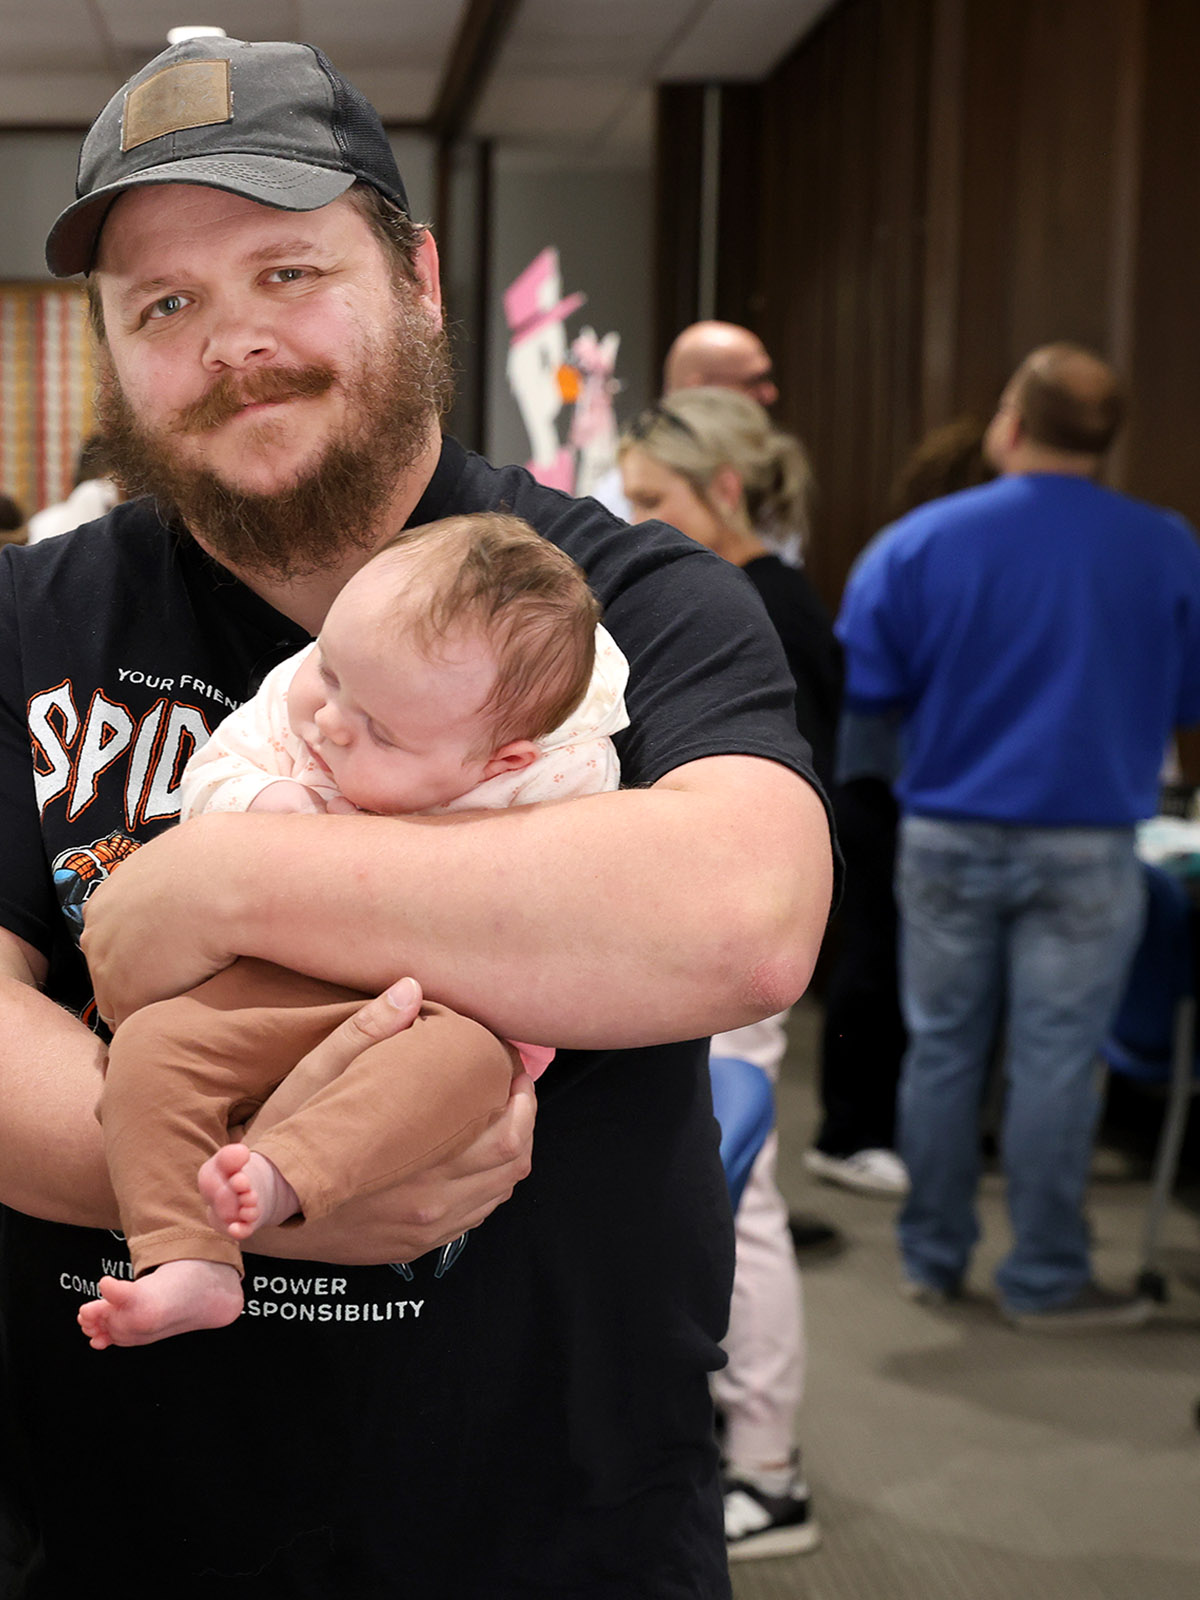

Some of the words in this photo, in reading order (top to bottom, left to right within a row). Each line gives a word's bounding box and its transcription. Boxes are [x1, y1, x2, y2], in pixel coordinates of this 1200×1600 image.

[118, 668, 174, 691] YOUR
[180, 675, 245, 710] FRIEN
[27, 678, 212, 832] SPID
[102, 1258, 133, 1279] WIT
[253, 1276, 347, 1295] POWER
[240, 1300, 424, 1321] SPONSIBILITY
